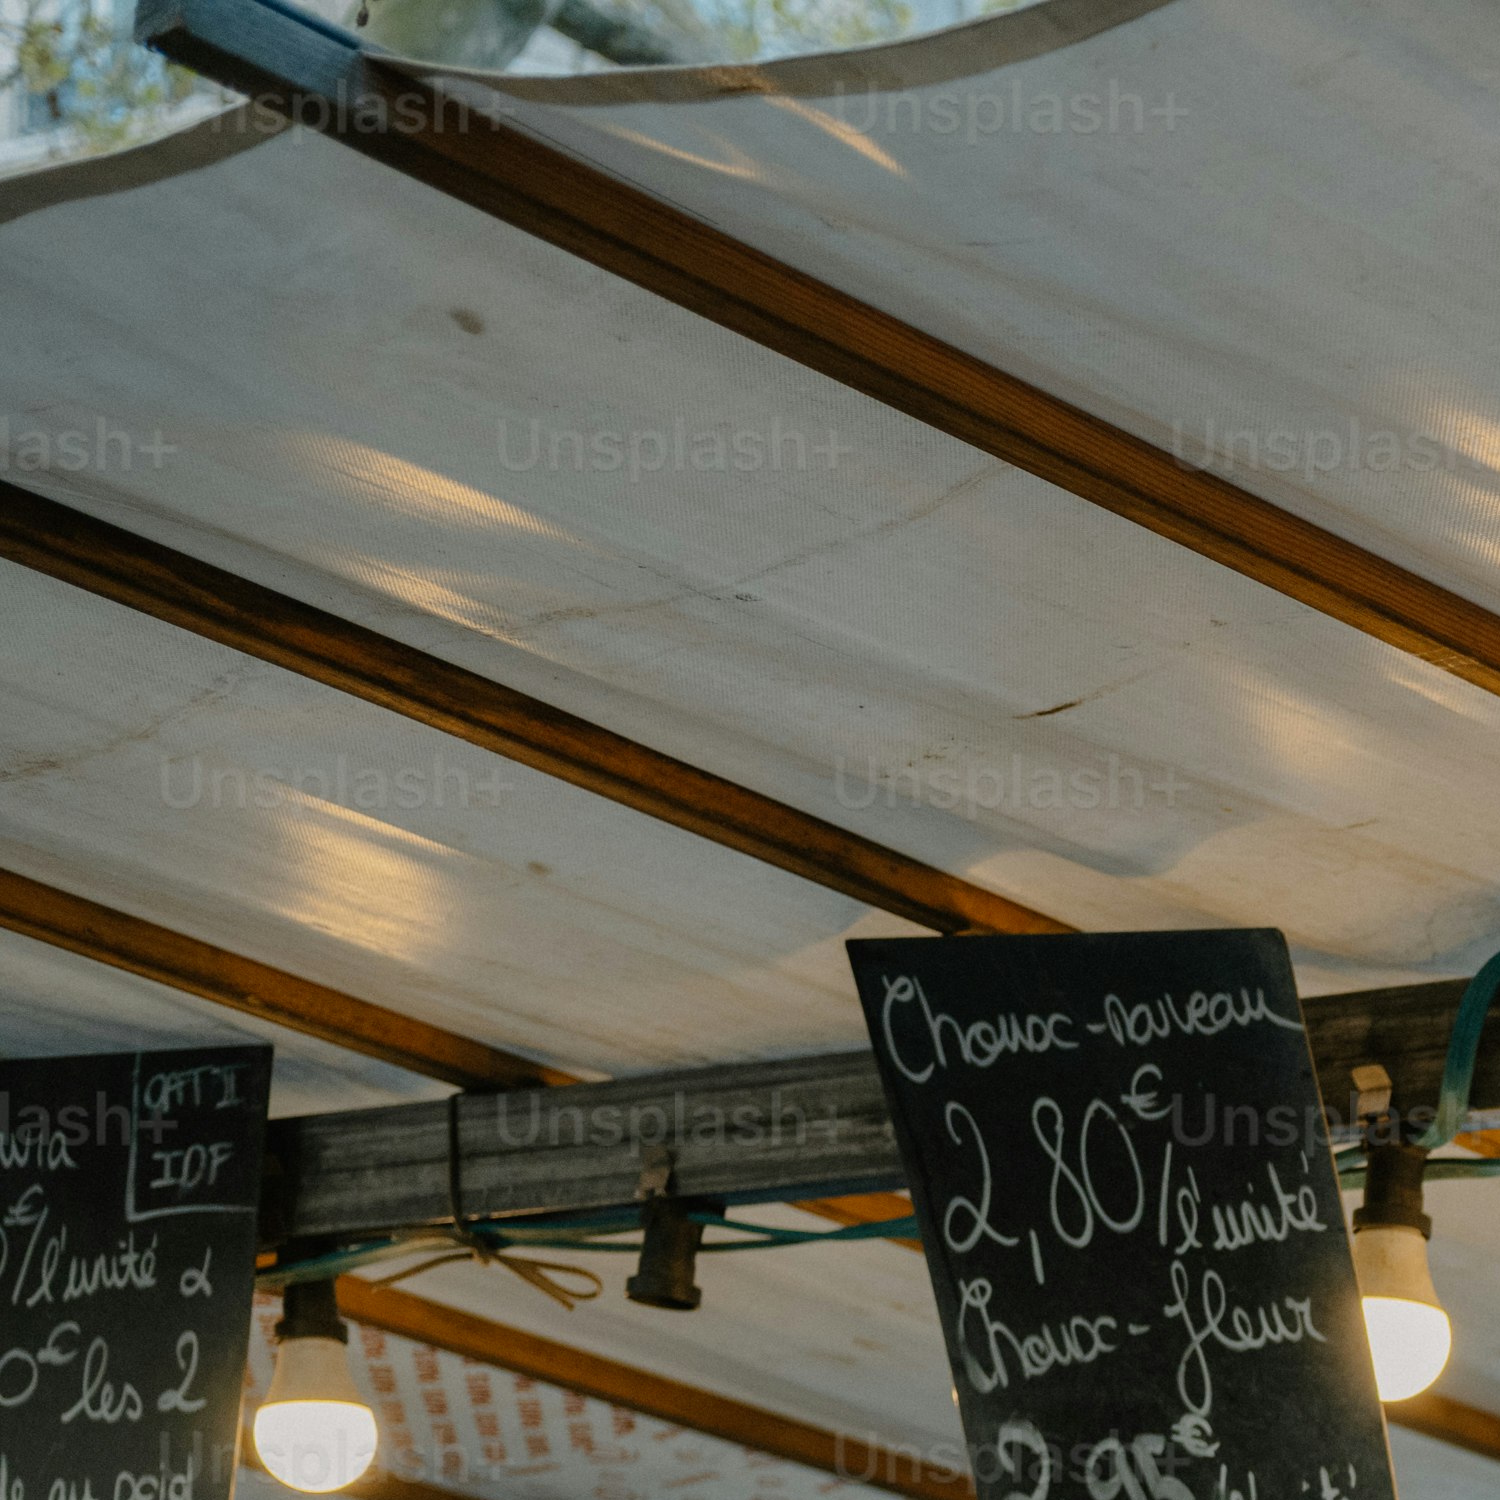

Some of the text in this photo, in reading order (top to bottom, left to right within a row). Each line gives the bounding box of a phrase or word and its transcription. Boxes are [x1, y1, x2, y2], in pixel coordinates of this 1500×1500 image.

[149, 1141, 233, 1190] IDF
[61, 1336, 144, 1425] les
[157, 1329, 207, 1413] 2
